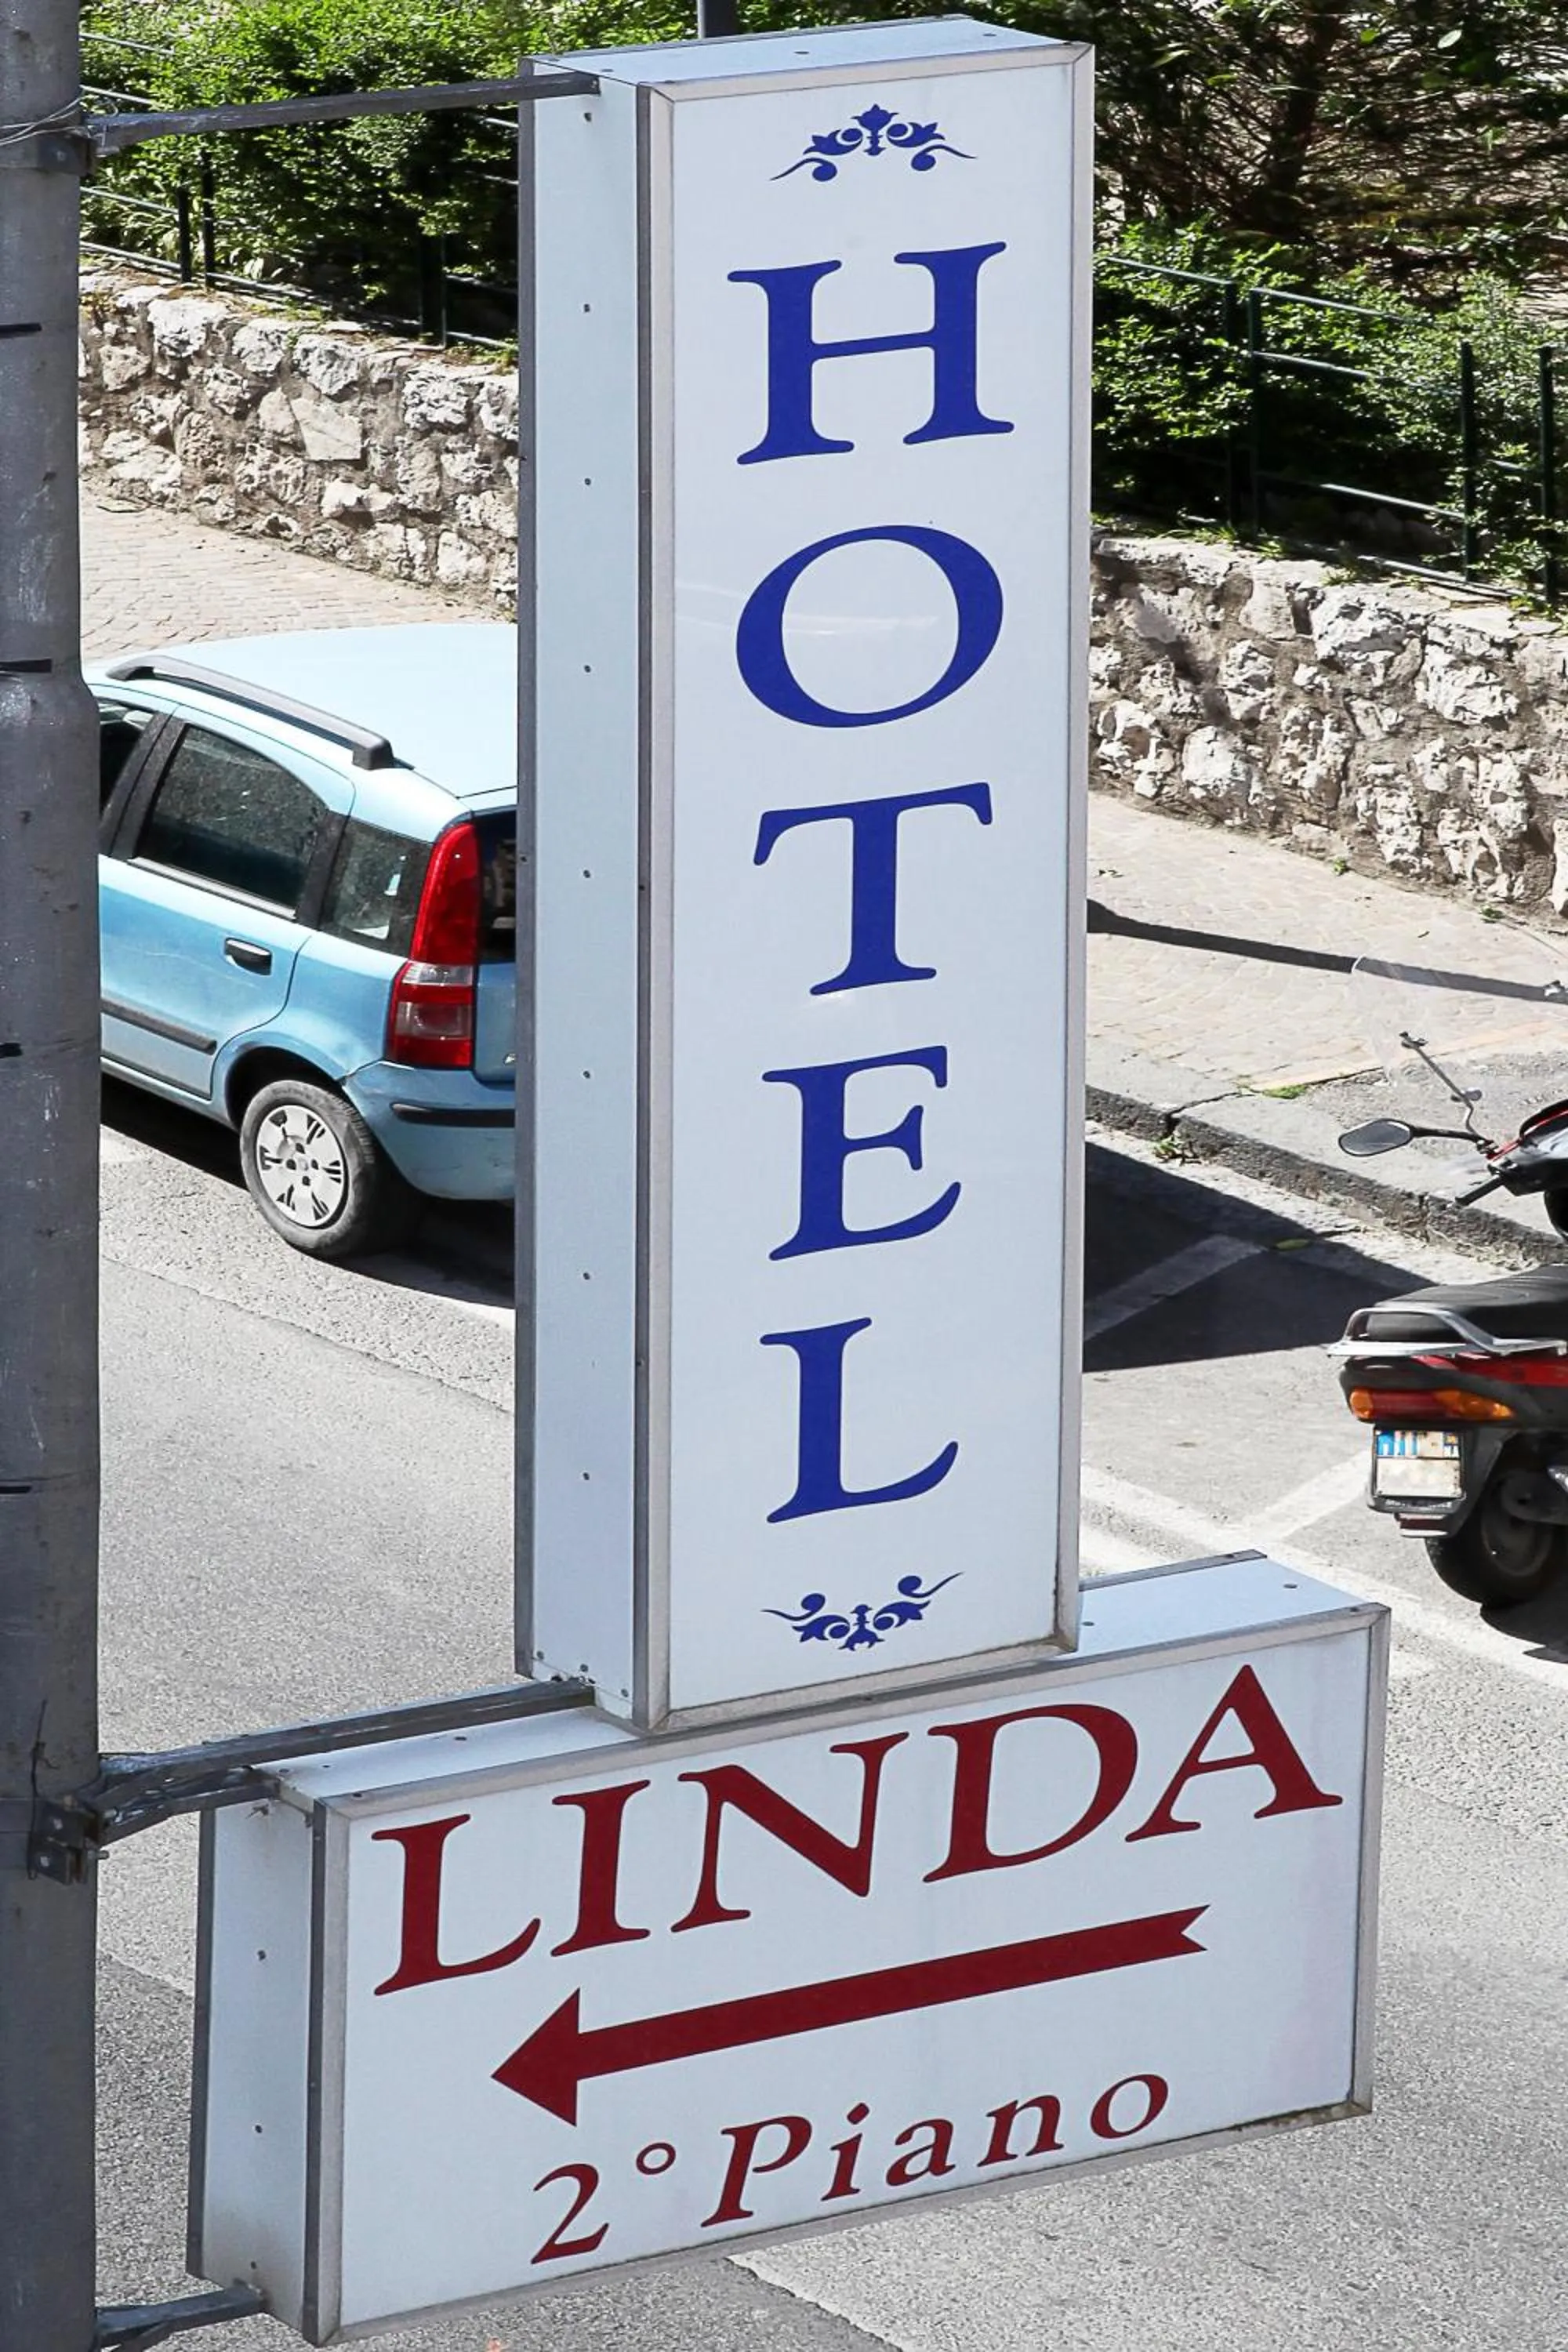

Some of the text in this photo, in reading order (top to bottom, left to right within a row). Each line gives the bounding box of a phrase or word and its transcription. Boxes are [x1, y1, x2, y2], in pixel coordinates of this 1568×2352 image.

[728, 242, 1014, 1523] HOTEL
[372, 1664, 1342, 1994] LINDA
[701, 2073, 1168, 2228] Piano
